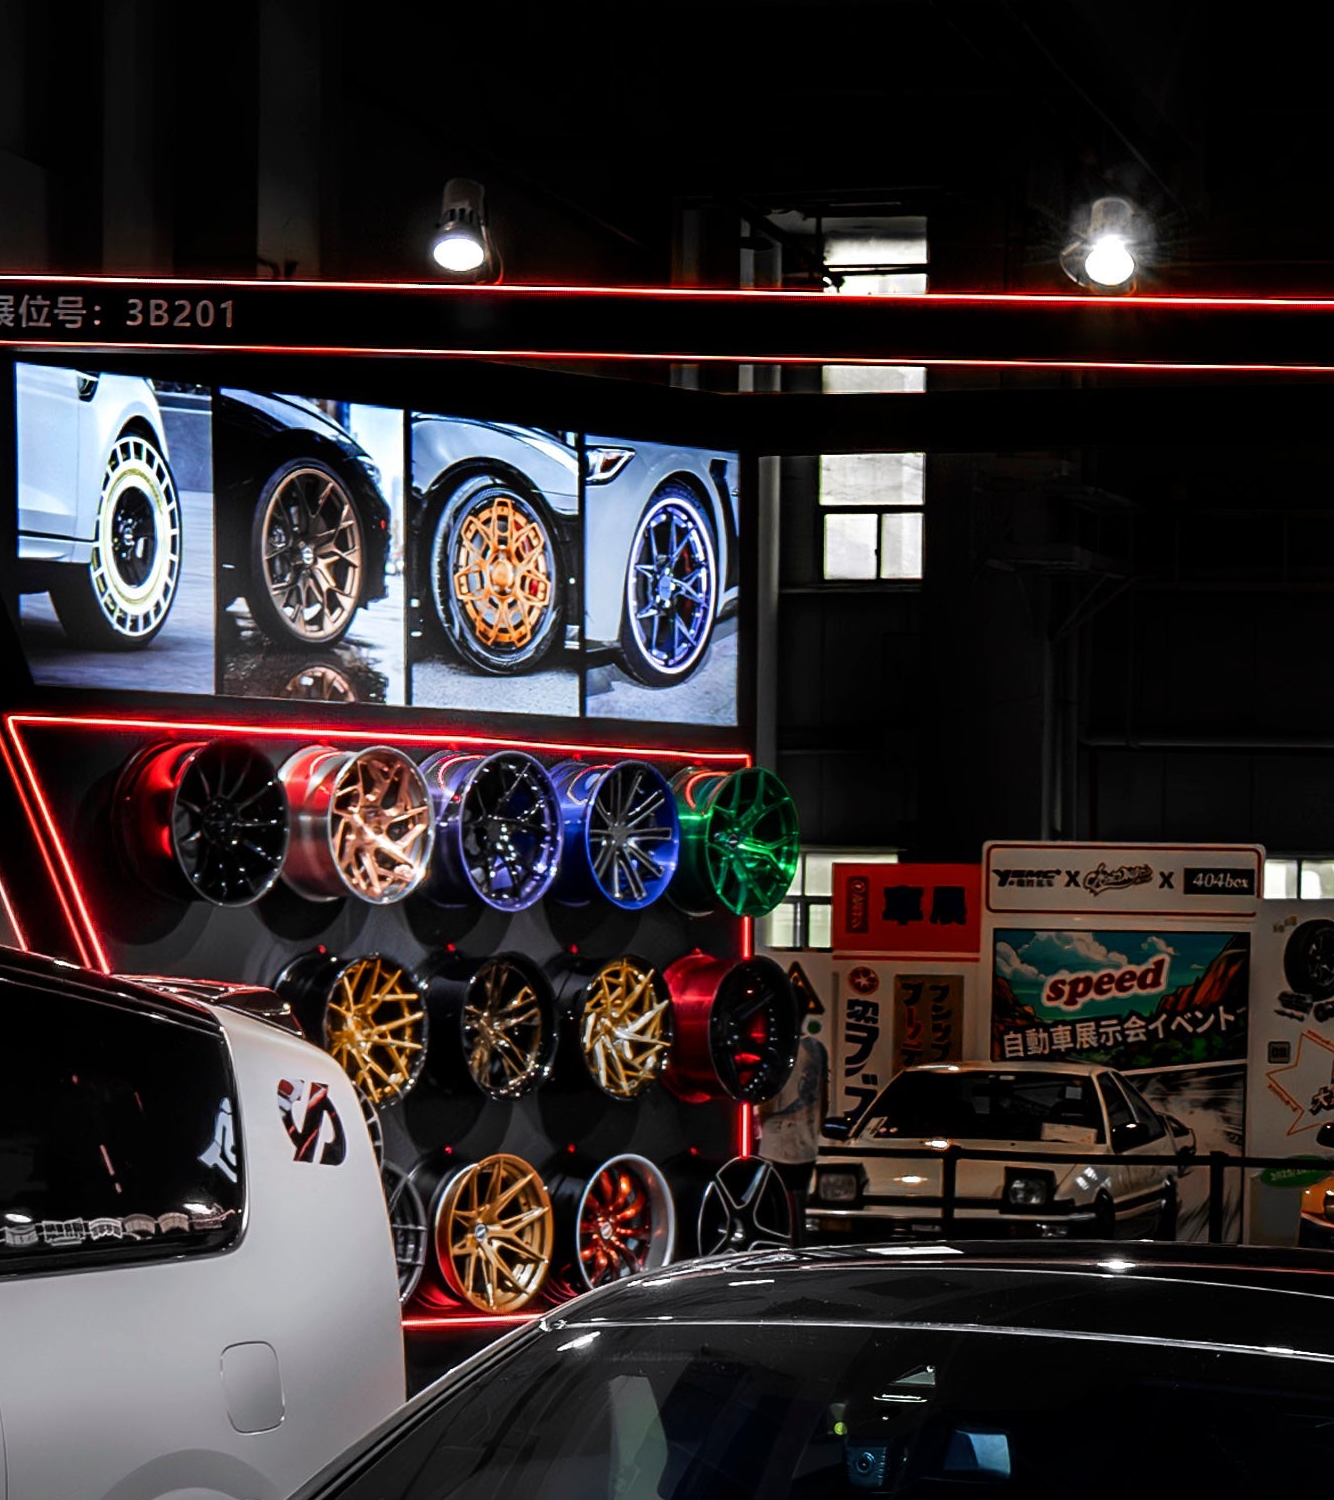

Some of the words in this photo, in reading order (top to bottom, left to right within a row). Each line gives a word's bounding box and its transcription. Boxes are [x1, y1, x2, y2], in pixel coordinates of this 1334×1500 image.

[125, 298, 234, 329] 3B201
[1191, 871, 1251, 891] 404box
[1046, 957, 1166, 1007] speed
